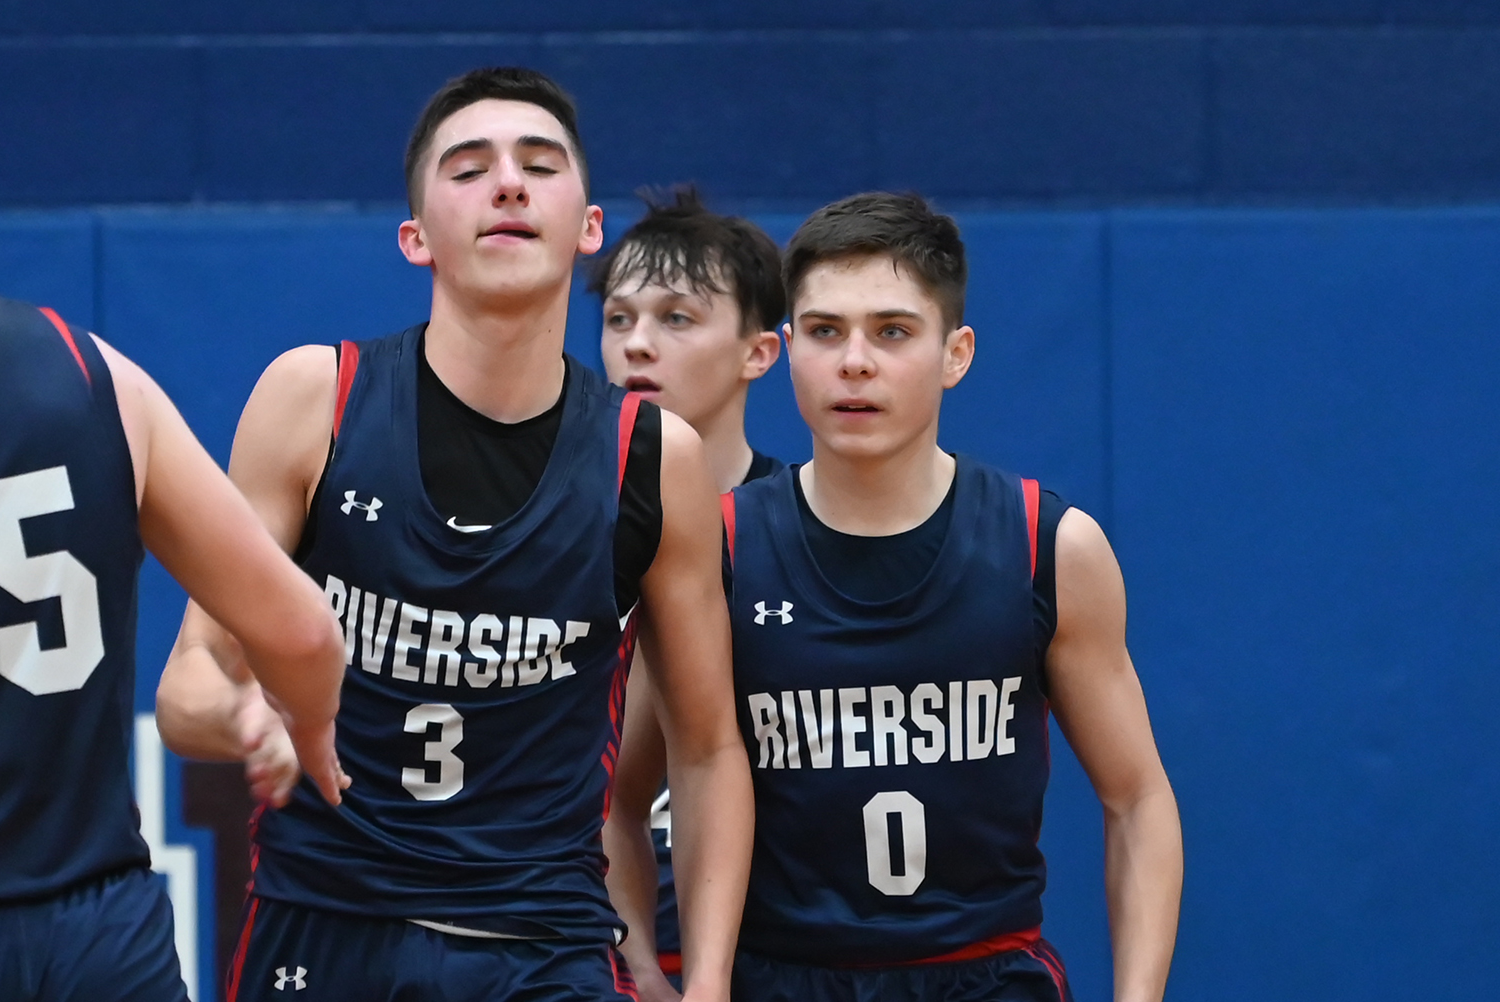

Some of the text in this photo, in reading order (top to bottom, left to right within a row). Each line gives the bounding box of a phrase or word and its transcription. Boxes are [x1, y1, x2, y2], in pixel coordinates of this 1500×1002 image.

[401, 703, 465, 801] 3
[748, 676, 1022, 769] RIVERSIDE
[862, 790, 927, 896] 0
